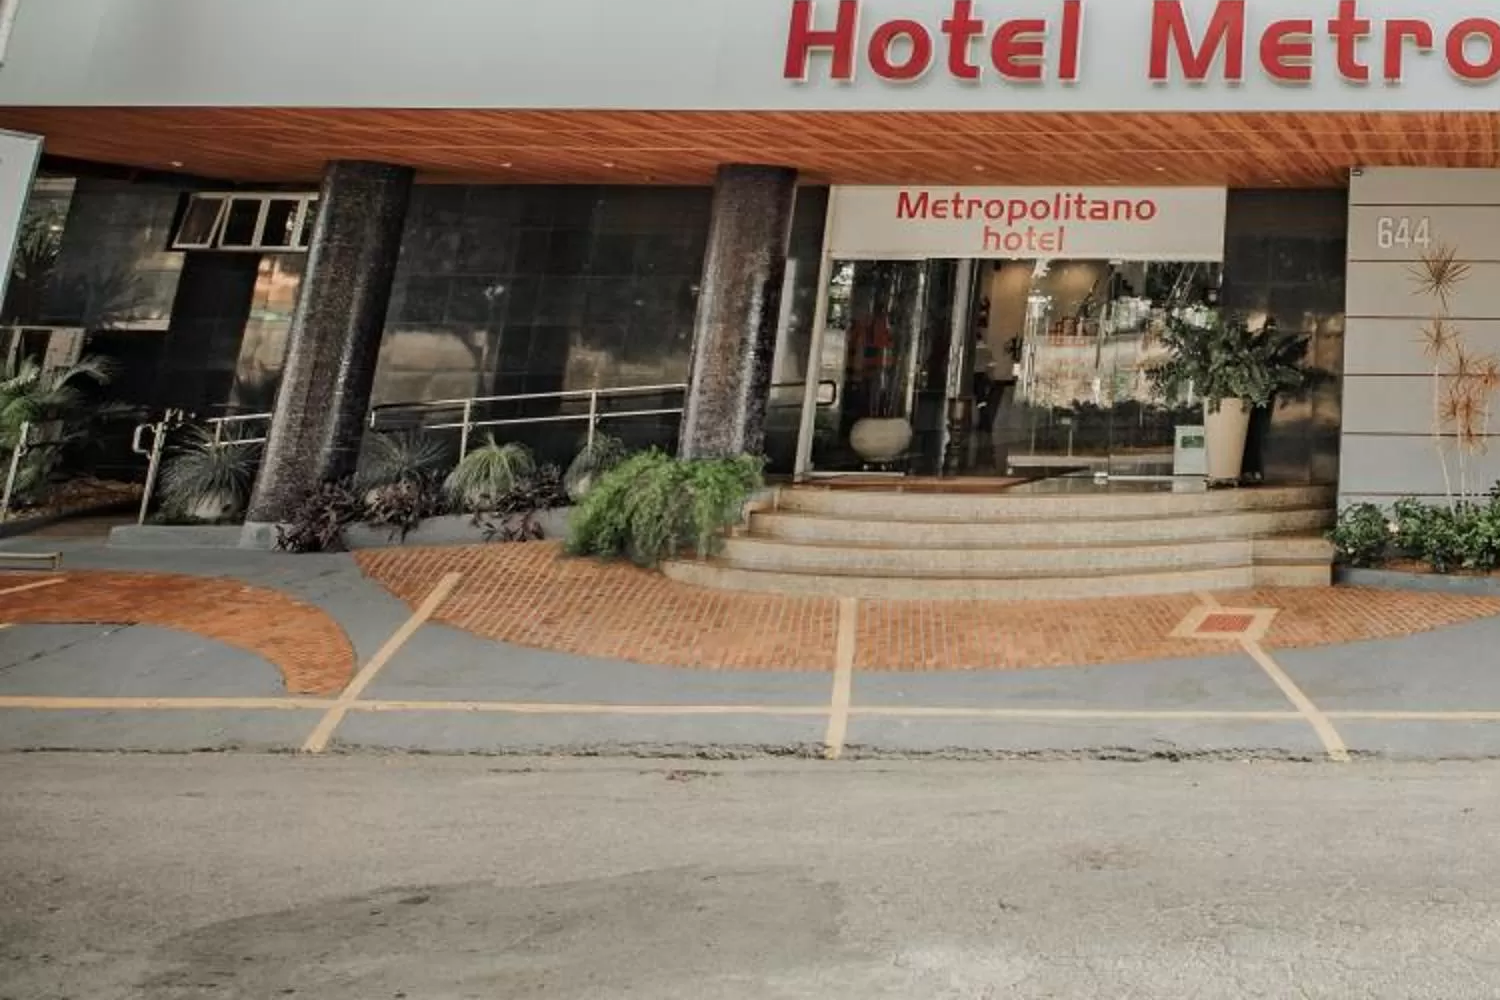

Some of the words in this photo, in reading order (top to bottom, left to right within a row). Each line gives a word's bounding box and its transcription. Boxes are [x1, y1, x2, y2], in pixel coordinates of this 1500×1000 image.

[896, 191, 1157, 225] Metropolitano
[982, 226, 1065, 252] hotel
[1378, 217, 1430, 249] 644
